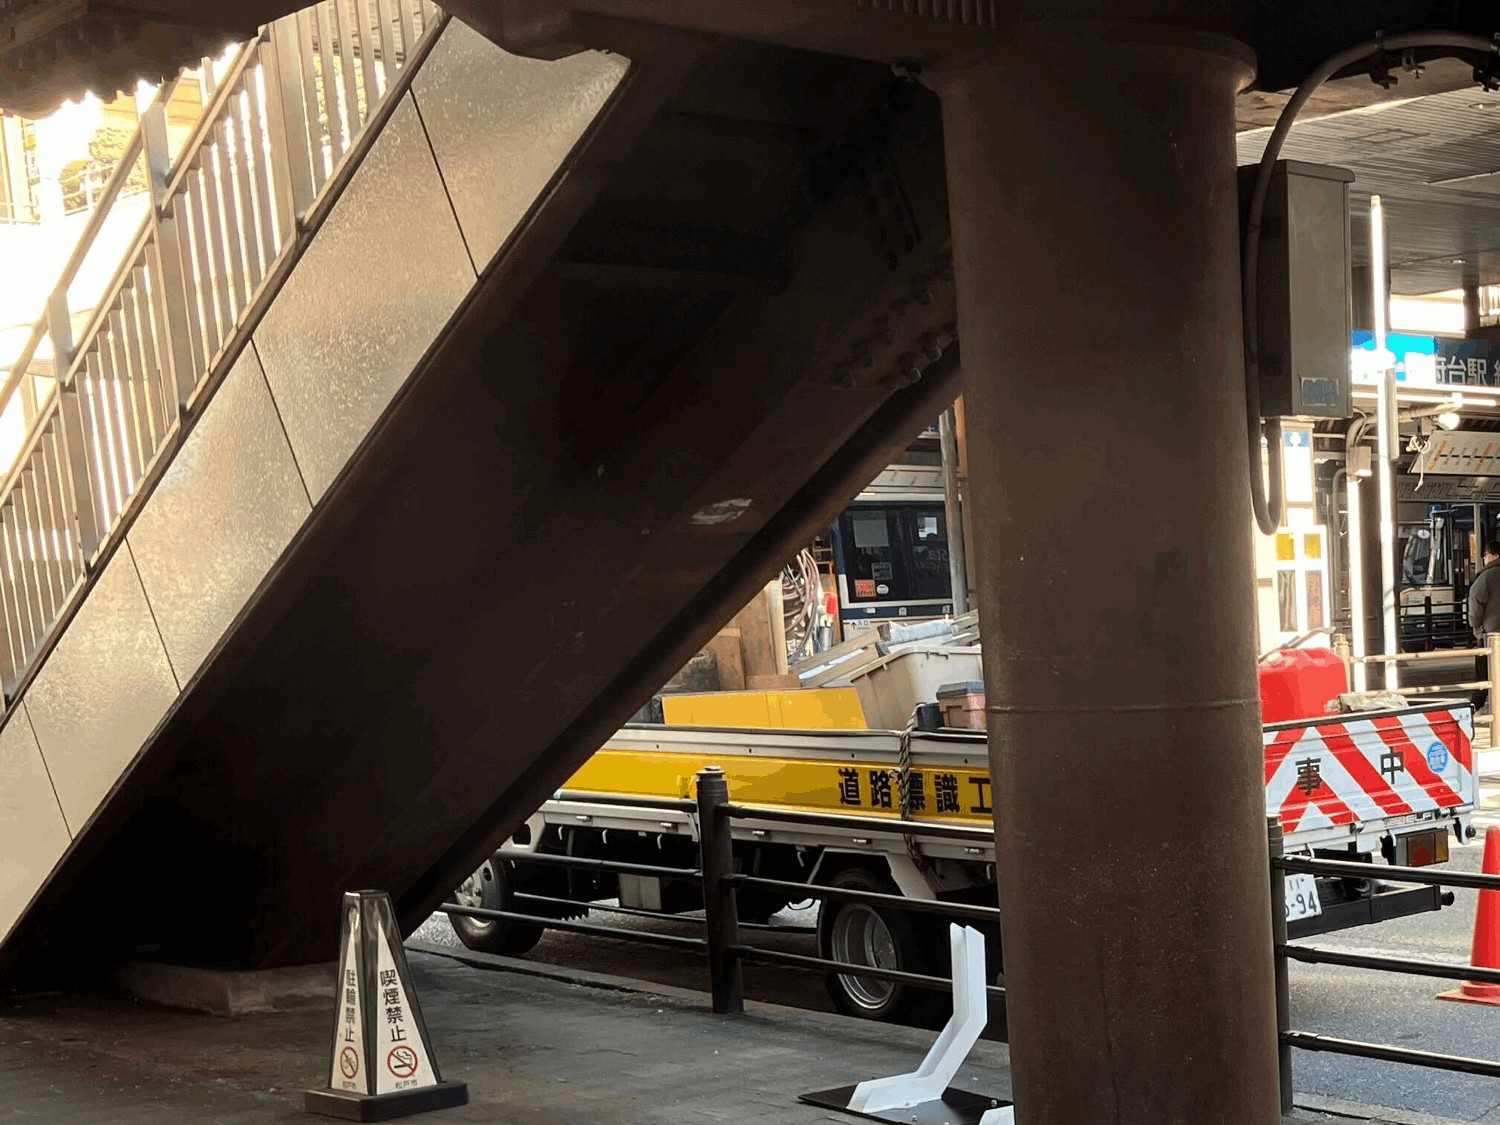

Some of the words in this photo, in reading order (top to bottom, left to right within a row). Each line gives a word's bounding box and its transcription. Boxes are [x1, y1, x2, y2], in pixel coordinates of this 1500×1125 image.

[344, 969, 356, 1043] 駐輪禁止
[379, 969, 407, 1043] 喫煙禁止
[395, 1078, 418, 1089] 松戸市
